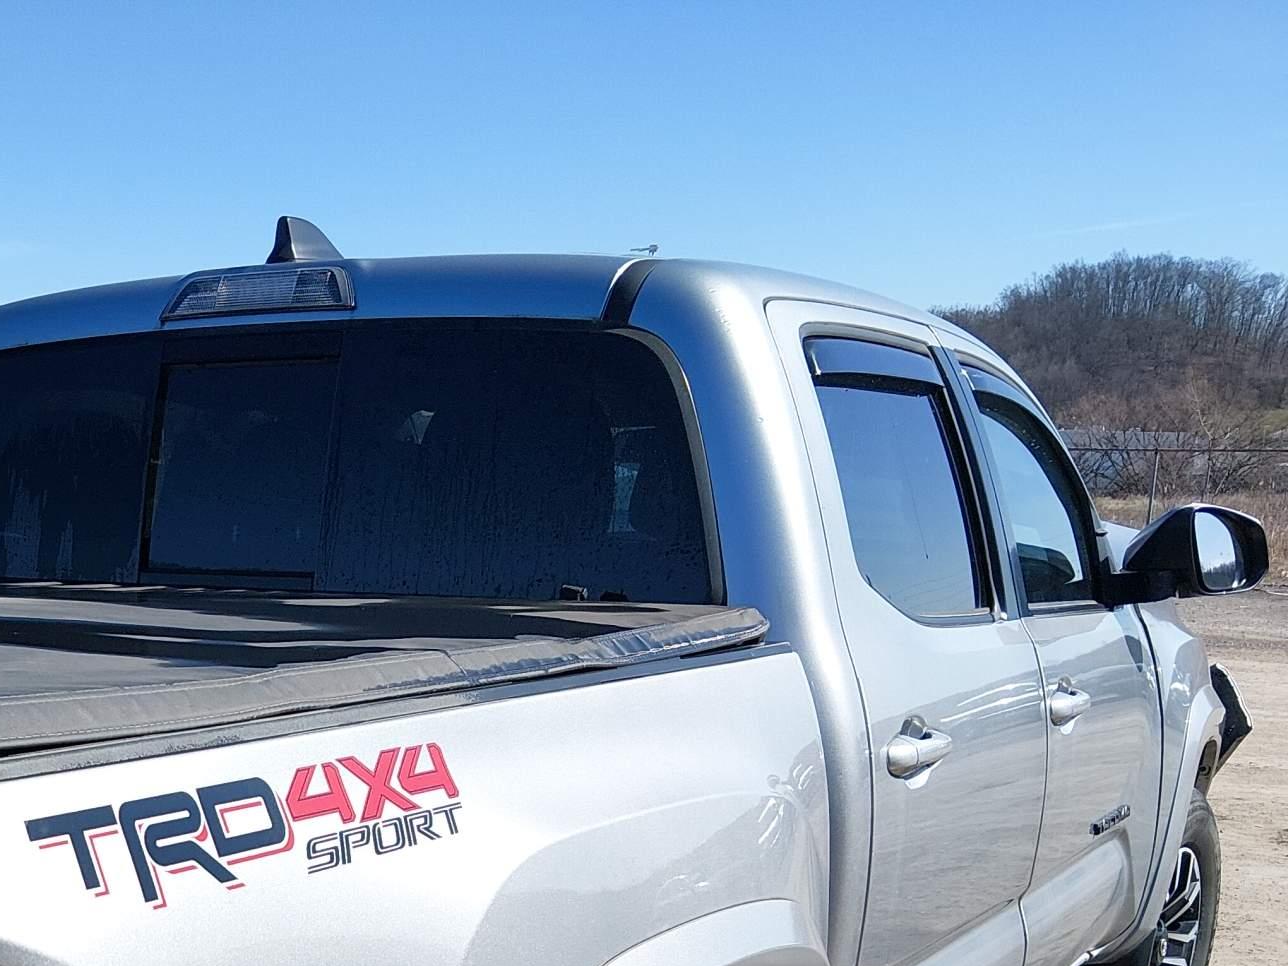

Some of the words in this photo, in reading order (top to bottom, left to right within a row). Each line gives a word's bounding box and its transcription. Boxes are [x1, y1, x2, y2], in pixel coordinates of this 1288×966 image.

[24, 776, 294, 910] TRD
[285, 742, 460, 823] 4X4
[307, 802, 463, 874] SPORT
